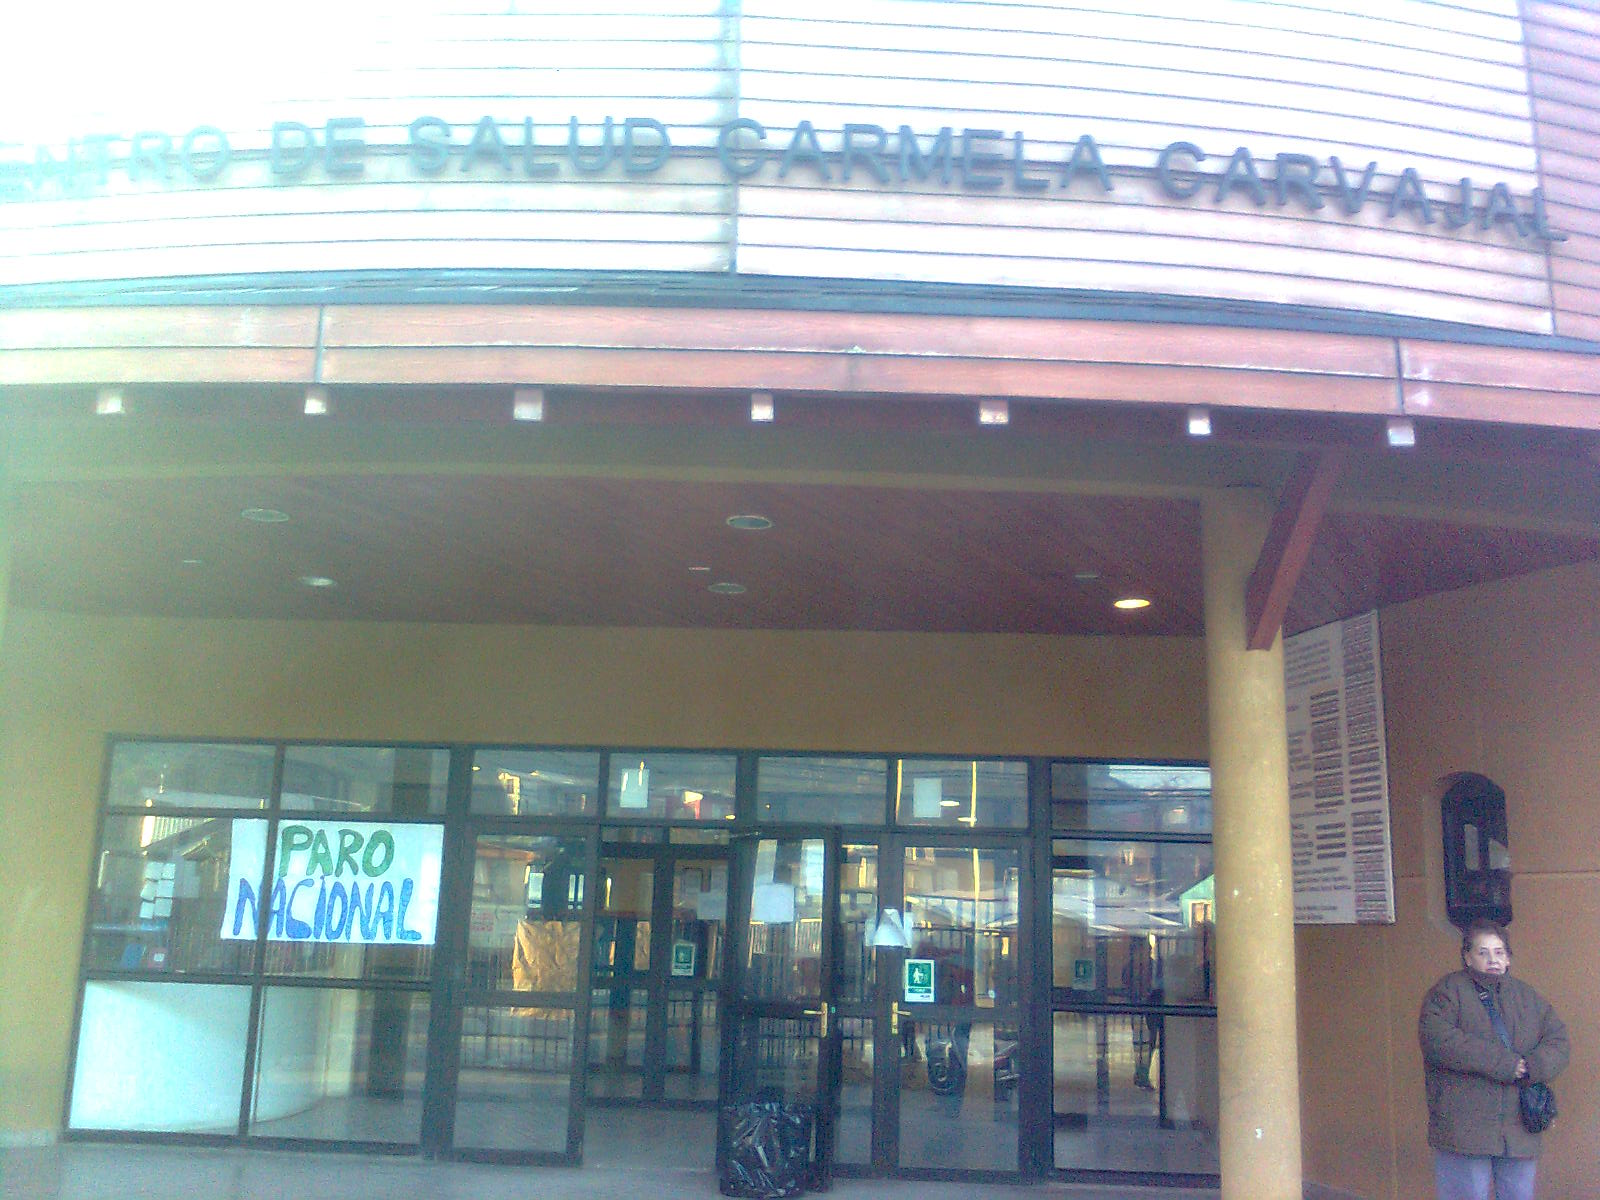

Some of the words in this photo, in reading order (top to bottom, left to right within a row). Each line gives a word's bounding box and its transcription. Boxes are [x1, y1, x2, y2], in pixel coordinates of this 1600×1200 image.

[270, 119, 366, 176] DE
[410, 115, 671, 175] SALUD
[718, 117, 1113, 193] CARMELA
[1156, 141, 1568, 243] CARVAJAL
[279, 825, 395, 877] PARO
[233, 876, 422, 941] NACIONAL
